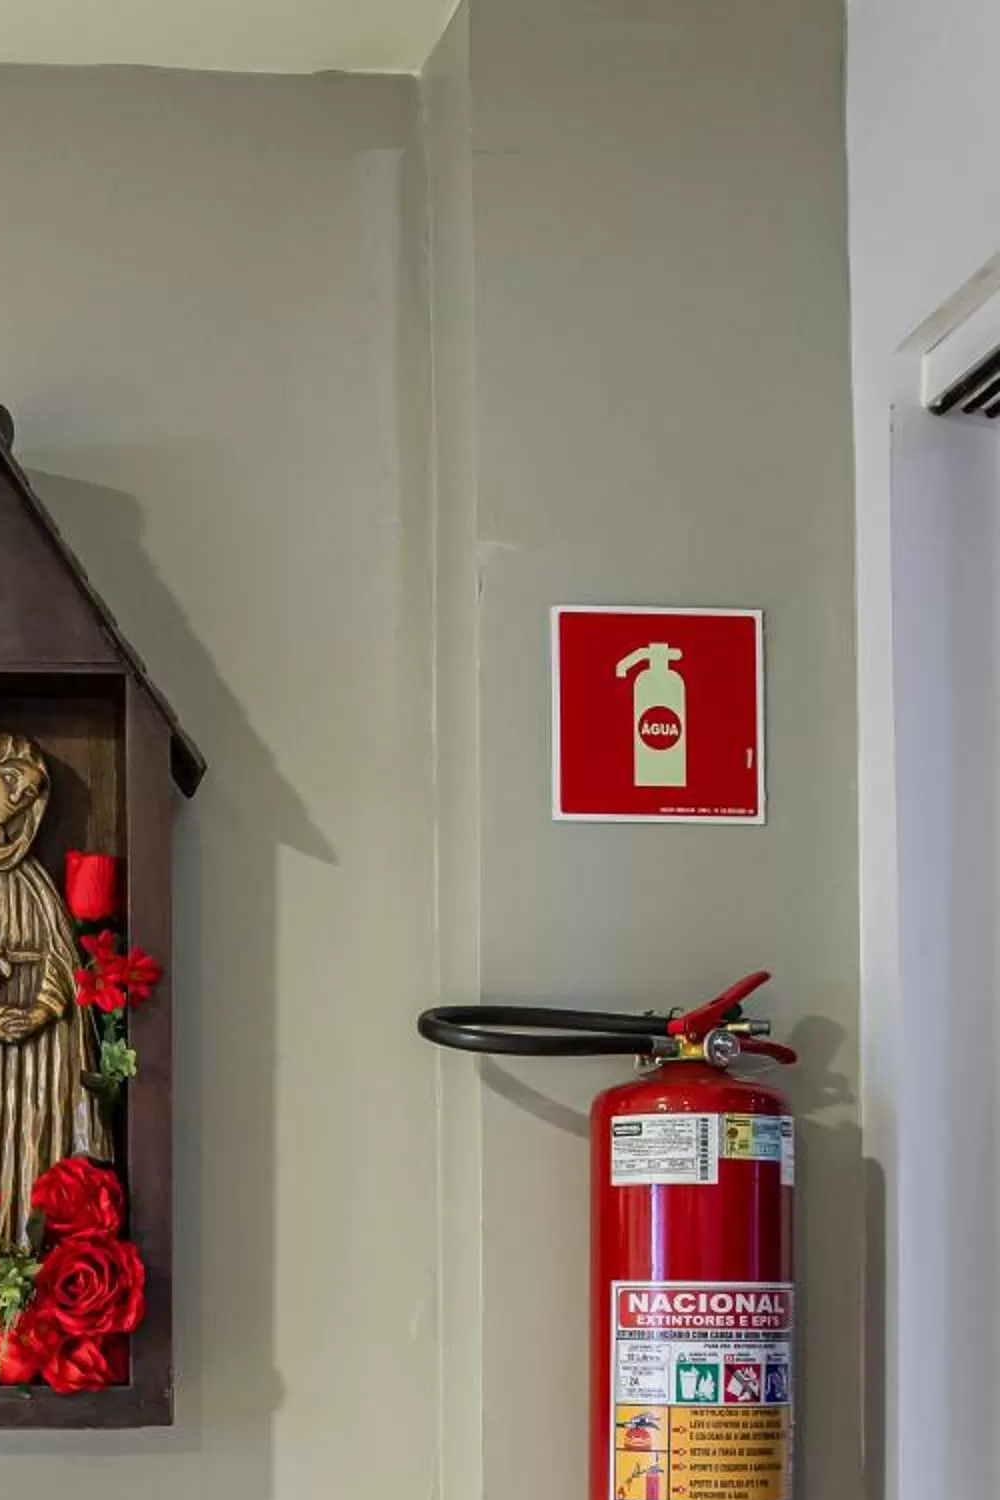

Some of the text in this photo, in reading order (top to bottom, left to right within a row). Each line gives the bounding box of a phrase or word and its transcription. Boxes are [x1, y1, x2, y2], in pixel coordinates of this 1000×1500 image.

[641, 720, 679, 737] ÁGUA
[628, 1293, 784, 1313] NACIONAL
[636, 1315, 735, 1327] EXTINTORES
[739, 1316, 748, 1326] E
